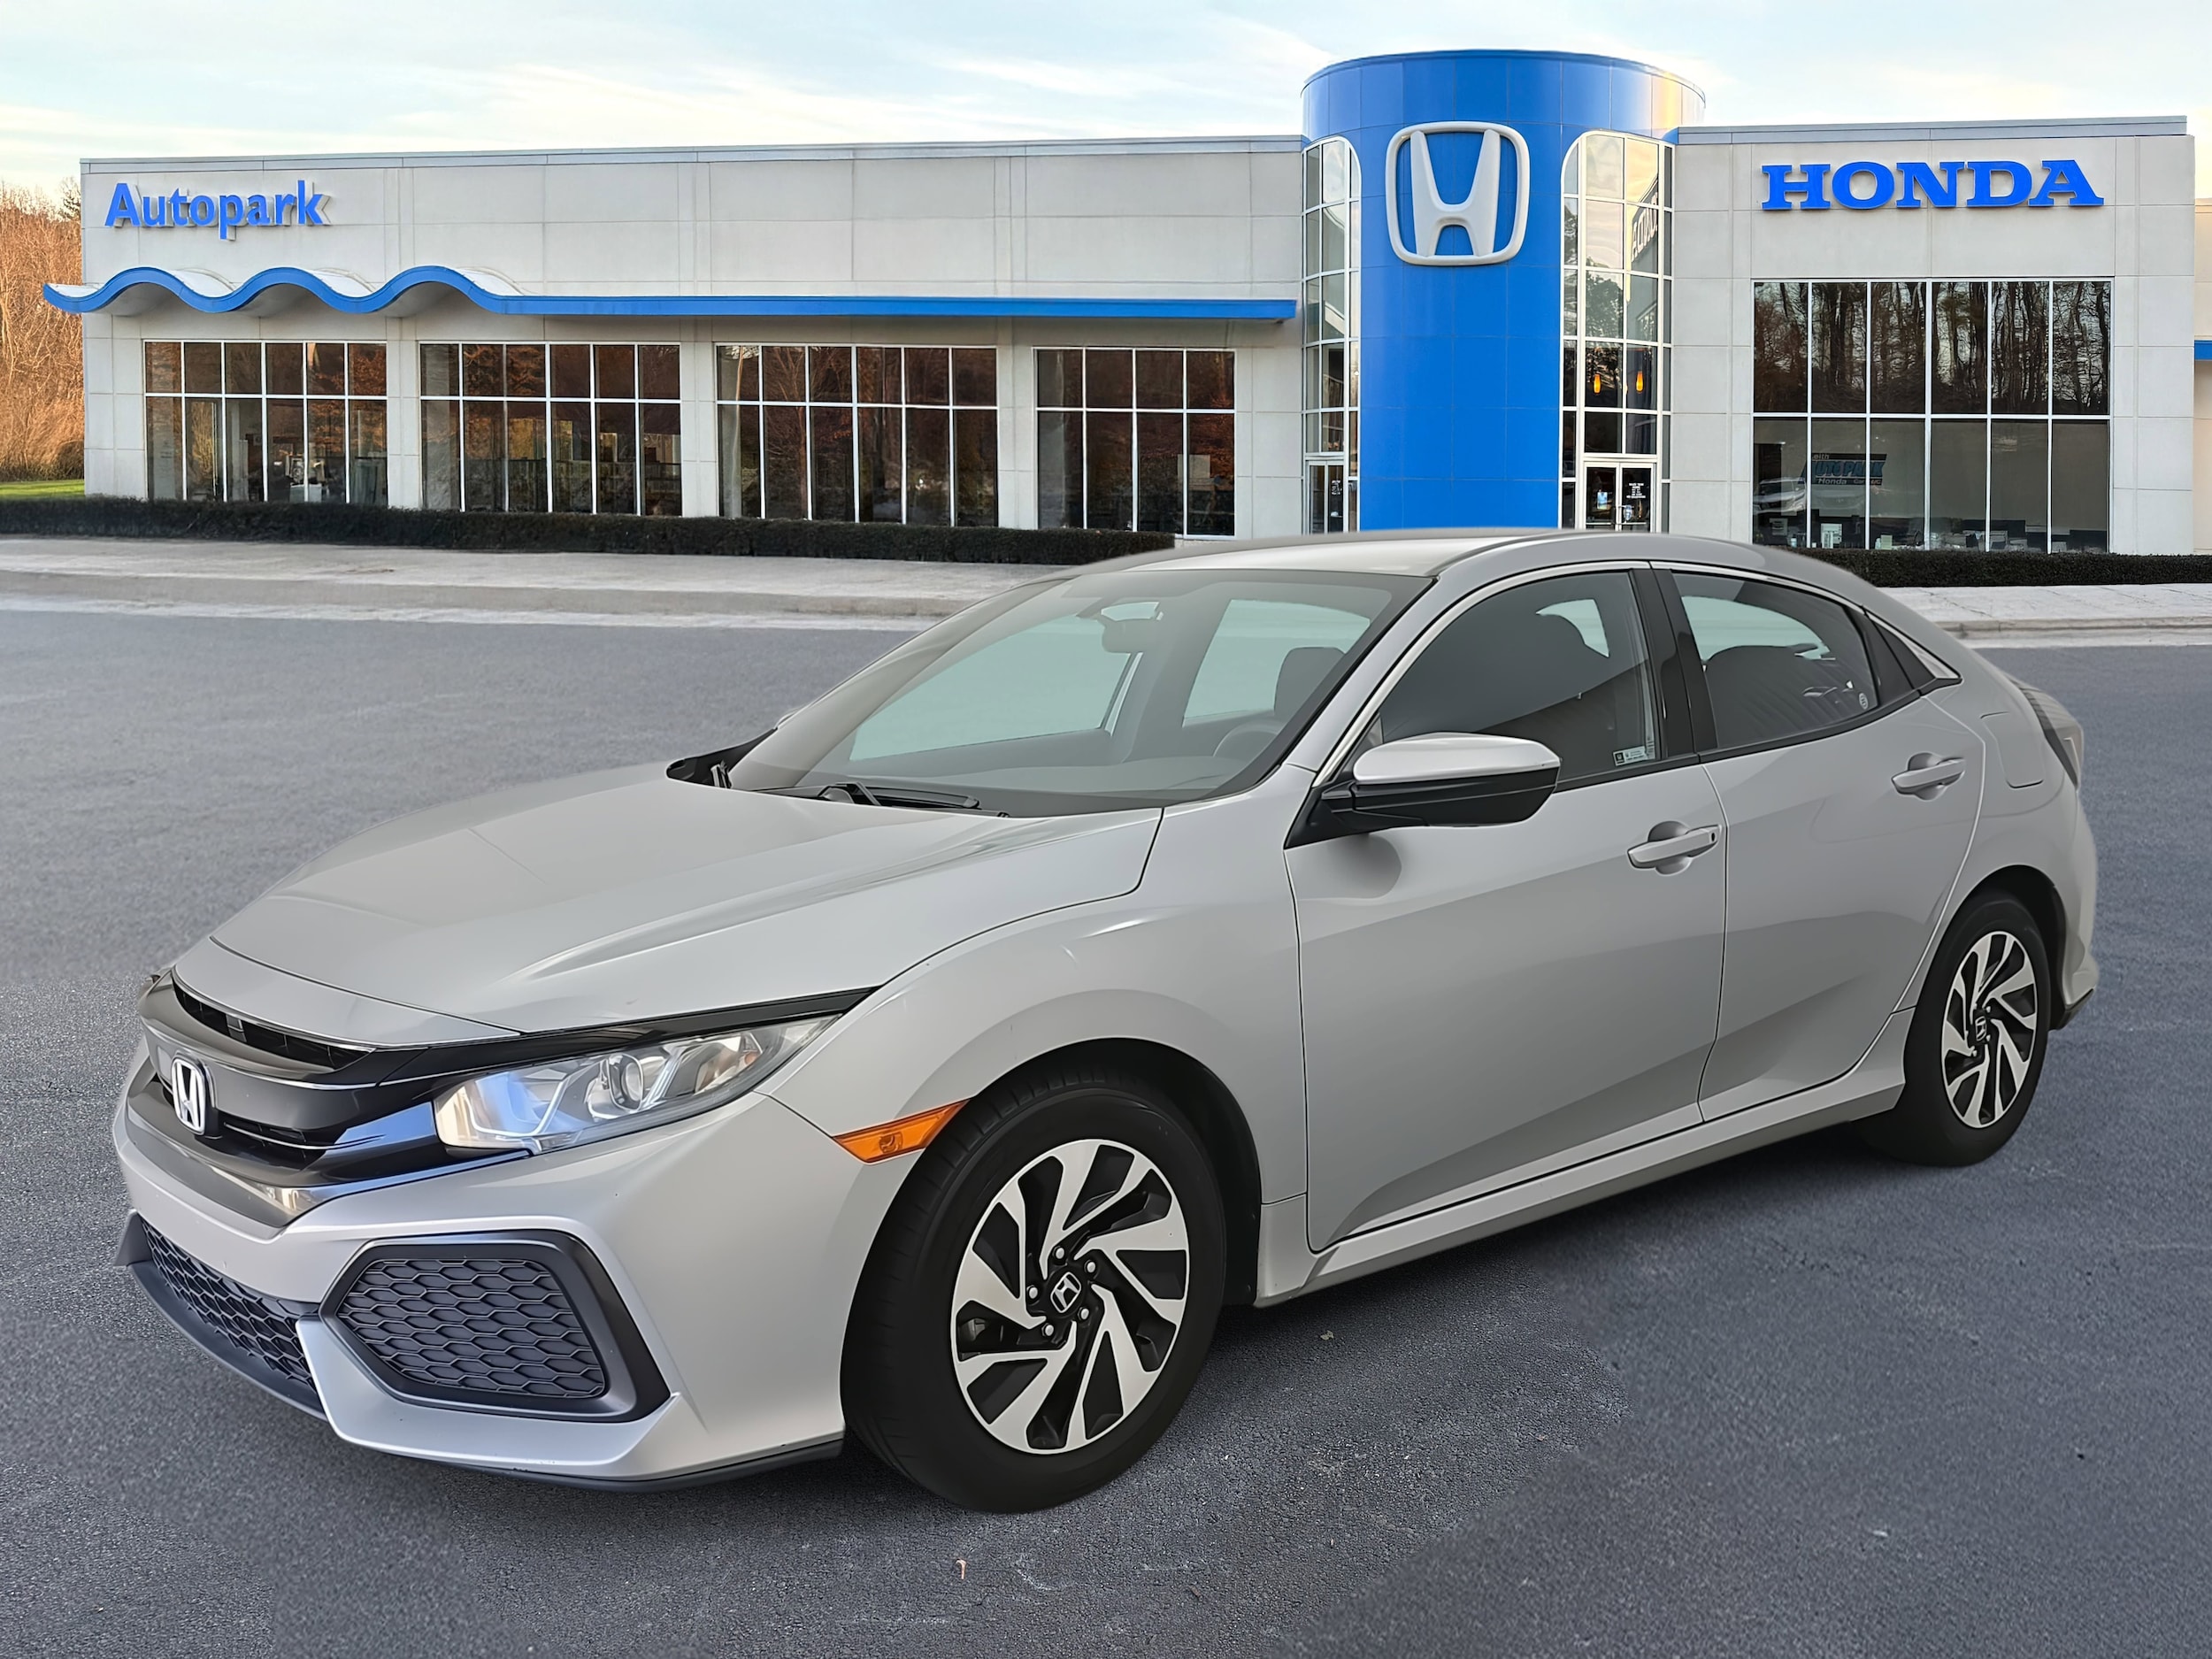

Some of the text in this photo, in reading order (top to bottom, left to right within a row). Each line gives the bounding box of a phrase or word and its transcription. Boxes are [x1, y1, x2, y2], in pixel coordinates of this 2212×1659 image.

[1762, 159, 2105, 210] HONDA
[104, 180, 327, 241] Autopark
[1802, 461, 1886, 477] UTOPAK
